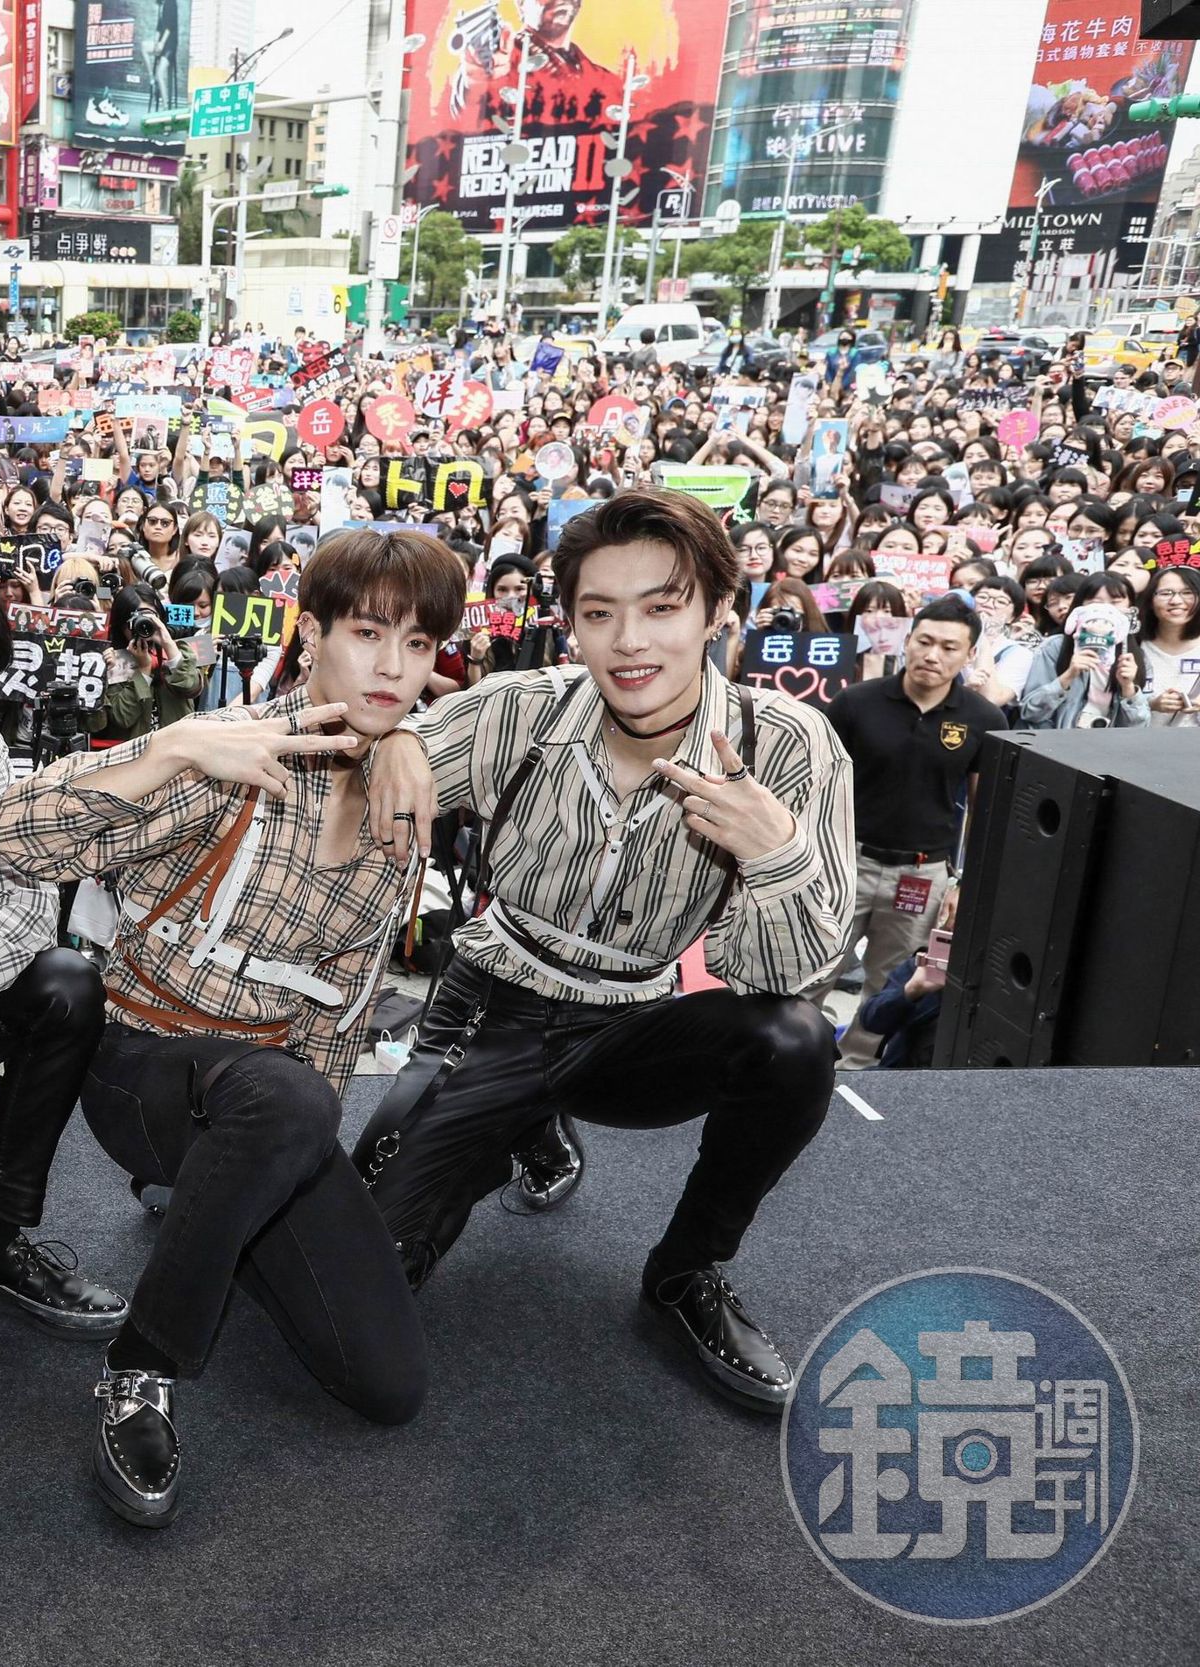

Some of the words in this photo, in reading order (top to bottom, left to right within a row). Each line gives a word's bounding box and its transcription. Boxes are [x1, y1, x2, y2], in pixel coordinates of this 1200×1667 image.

[200, 84, 250, 105] 漢中街
[514, 134, 577, 172] EAD
[1003, 212, 1103, 229] MIDTOWN
[1020, 228, 1076, 237] RICARDSON
[333, 294, 342, 314] 6
[422, 372, 455, 413] 洋
[1155, 398, 1190, 419] ONER
[211, 593, 281, 646] 卜凡
[761, 634, 841, 666] 岳岳
